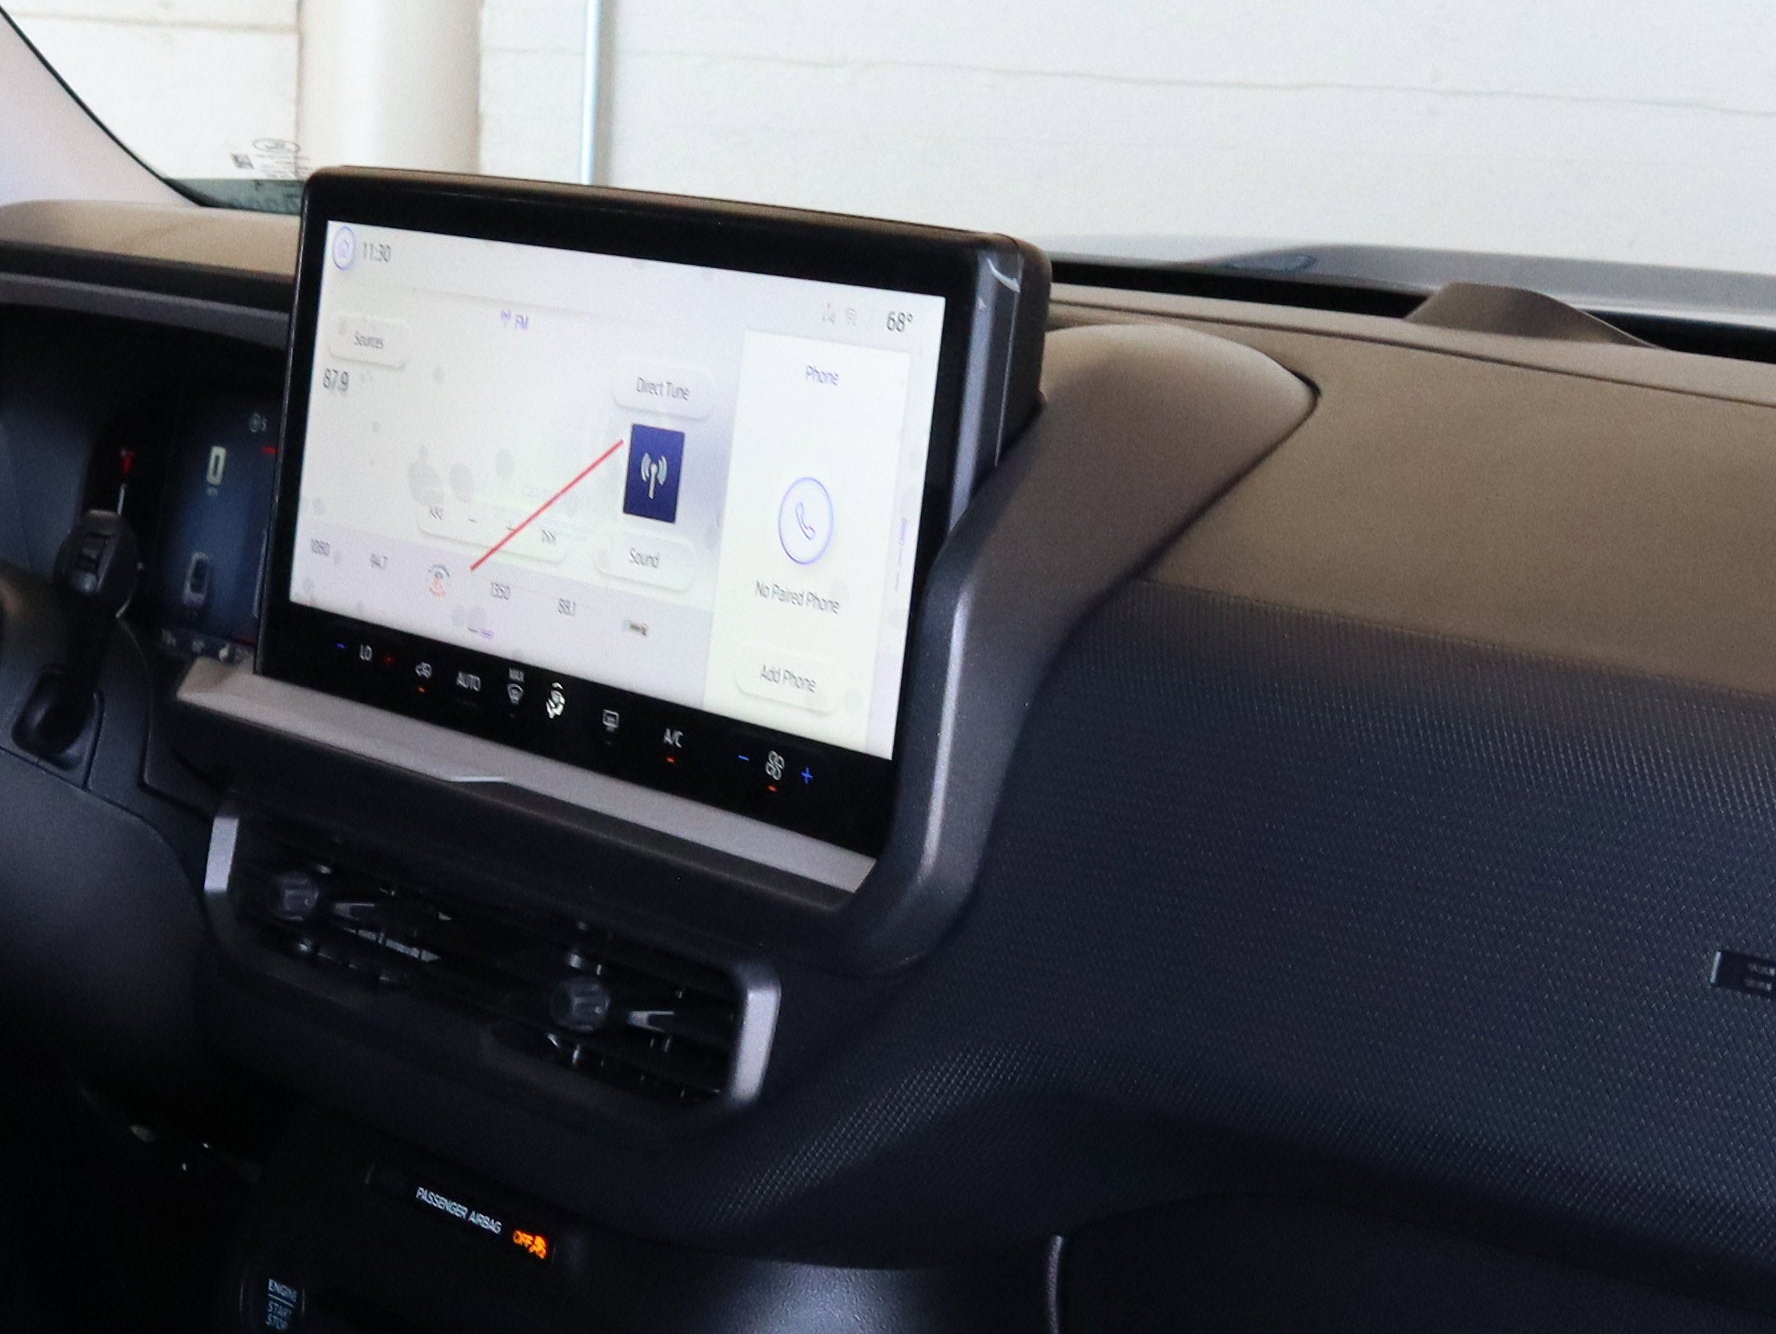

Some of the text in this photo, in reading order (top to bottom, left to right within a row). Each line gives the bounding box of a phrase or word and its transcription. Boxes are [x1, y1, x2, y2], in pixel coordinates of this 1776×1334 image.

[362, 242, 391, 263] 11:30
[805, 365, 840, 386] Phone
[636, 377, 690, 401] Direct Tune
[628, 547, 660, 569] Sound
[755, 581, 840, 615] No Paired Phone
[455, 670, 483, 692] AUTO
[760, 665, 816, 693] Add Phone
[415, 1186, 469, 1219] PASSENGER
[468, 1210, 502, 1235] AIRBAG
